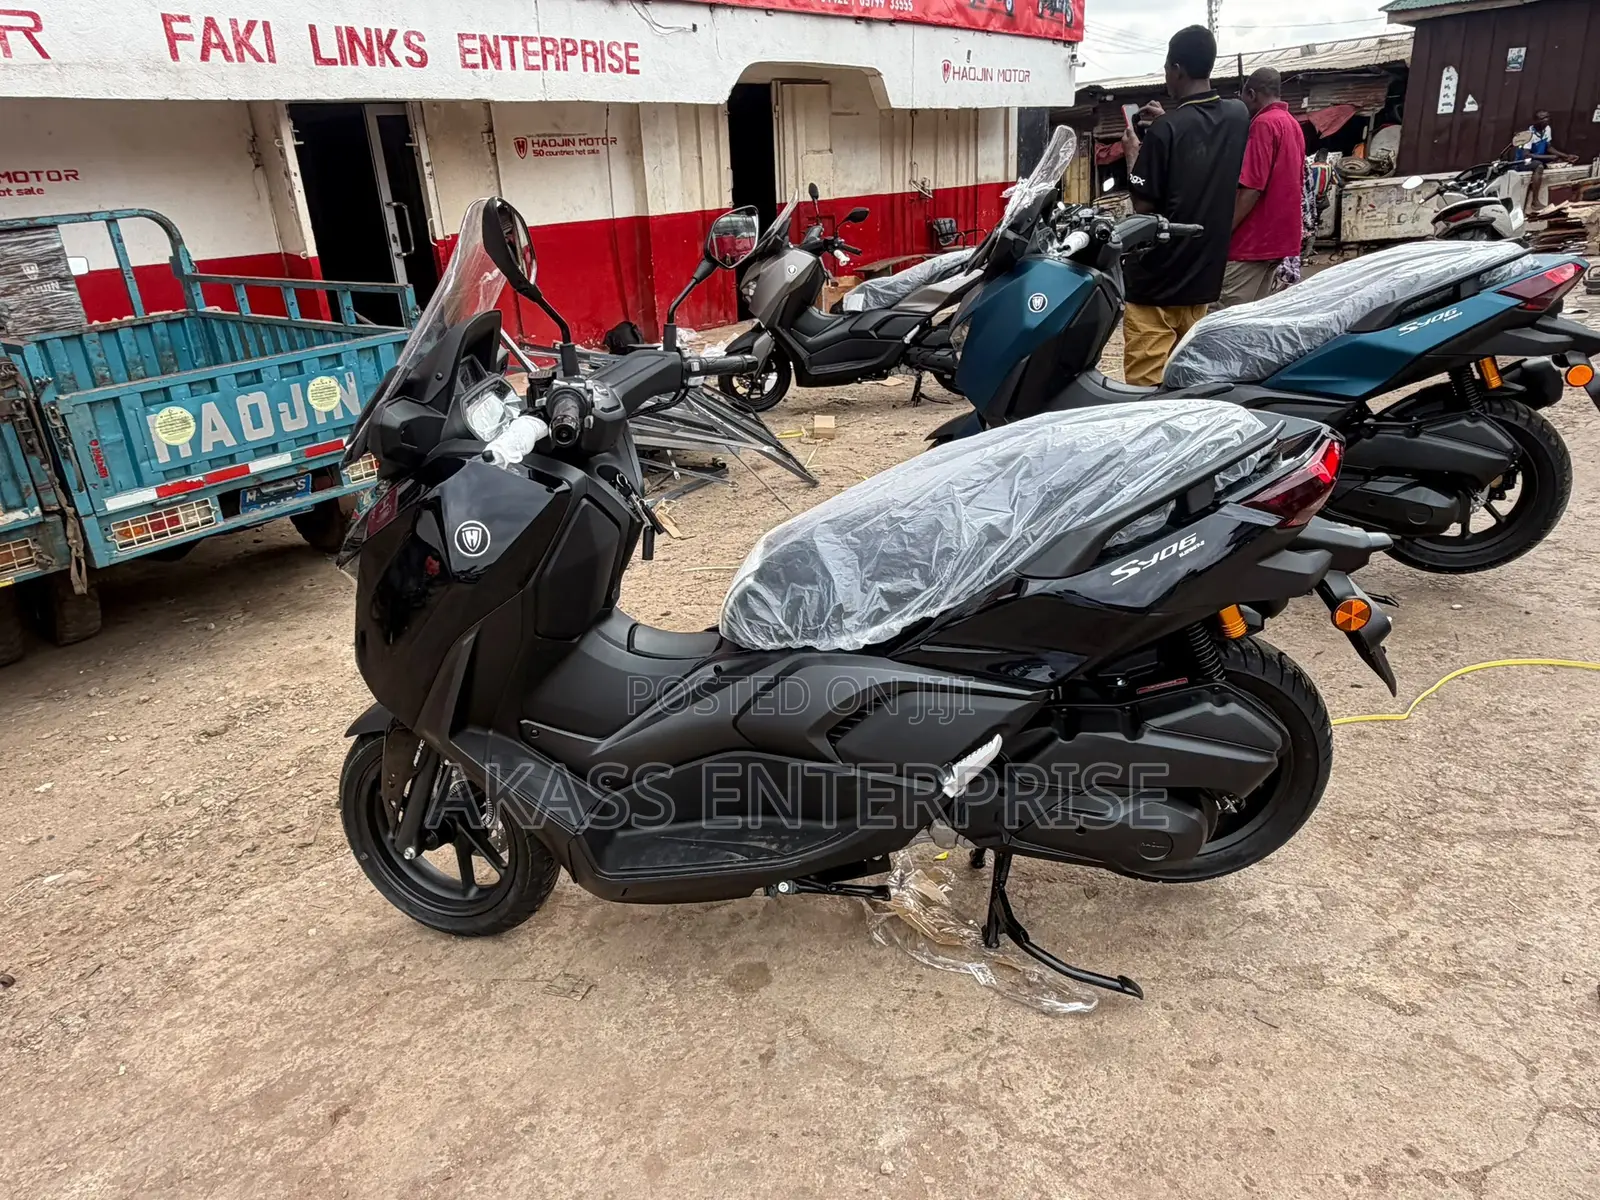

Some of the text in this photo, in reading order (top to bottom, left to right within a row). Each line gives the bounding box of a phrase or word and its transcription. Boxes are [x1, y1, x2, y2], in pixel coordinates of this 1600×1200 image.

[160, 12, 277, 64] FAKI
[308, 23, 429, 69] LINKS
[457, 32, 641, 75] ENTERPRISE
[952, 65, 994, 82] HAOJIN
[997, 68, 1031, 83] MOTOR
[531, 138, 576, 148] HAOJIN
[578, 136, 618, 147] MOTOR
[532, 149, 545, 157] 50
[545, 148, 575, 157] countries
[575, 148, 586, 156] hot
[16, 186, 45, 196] sale
